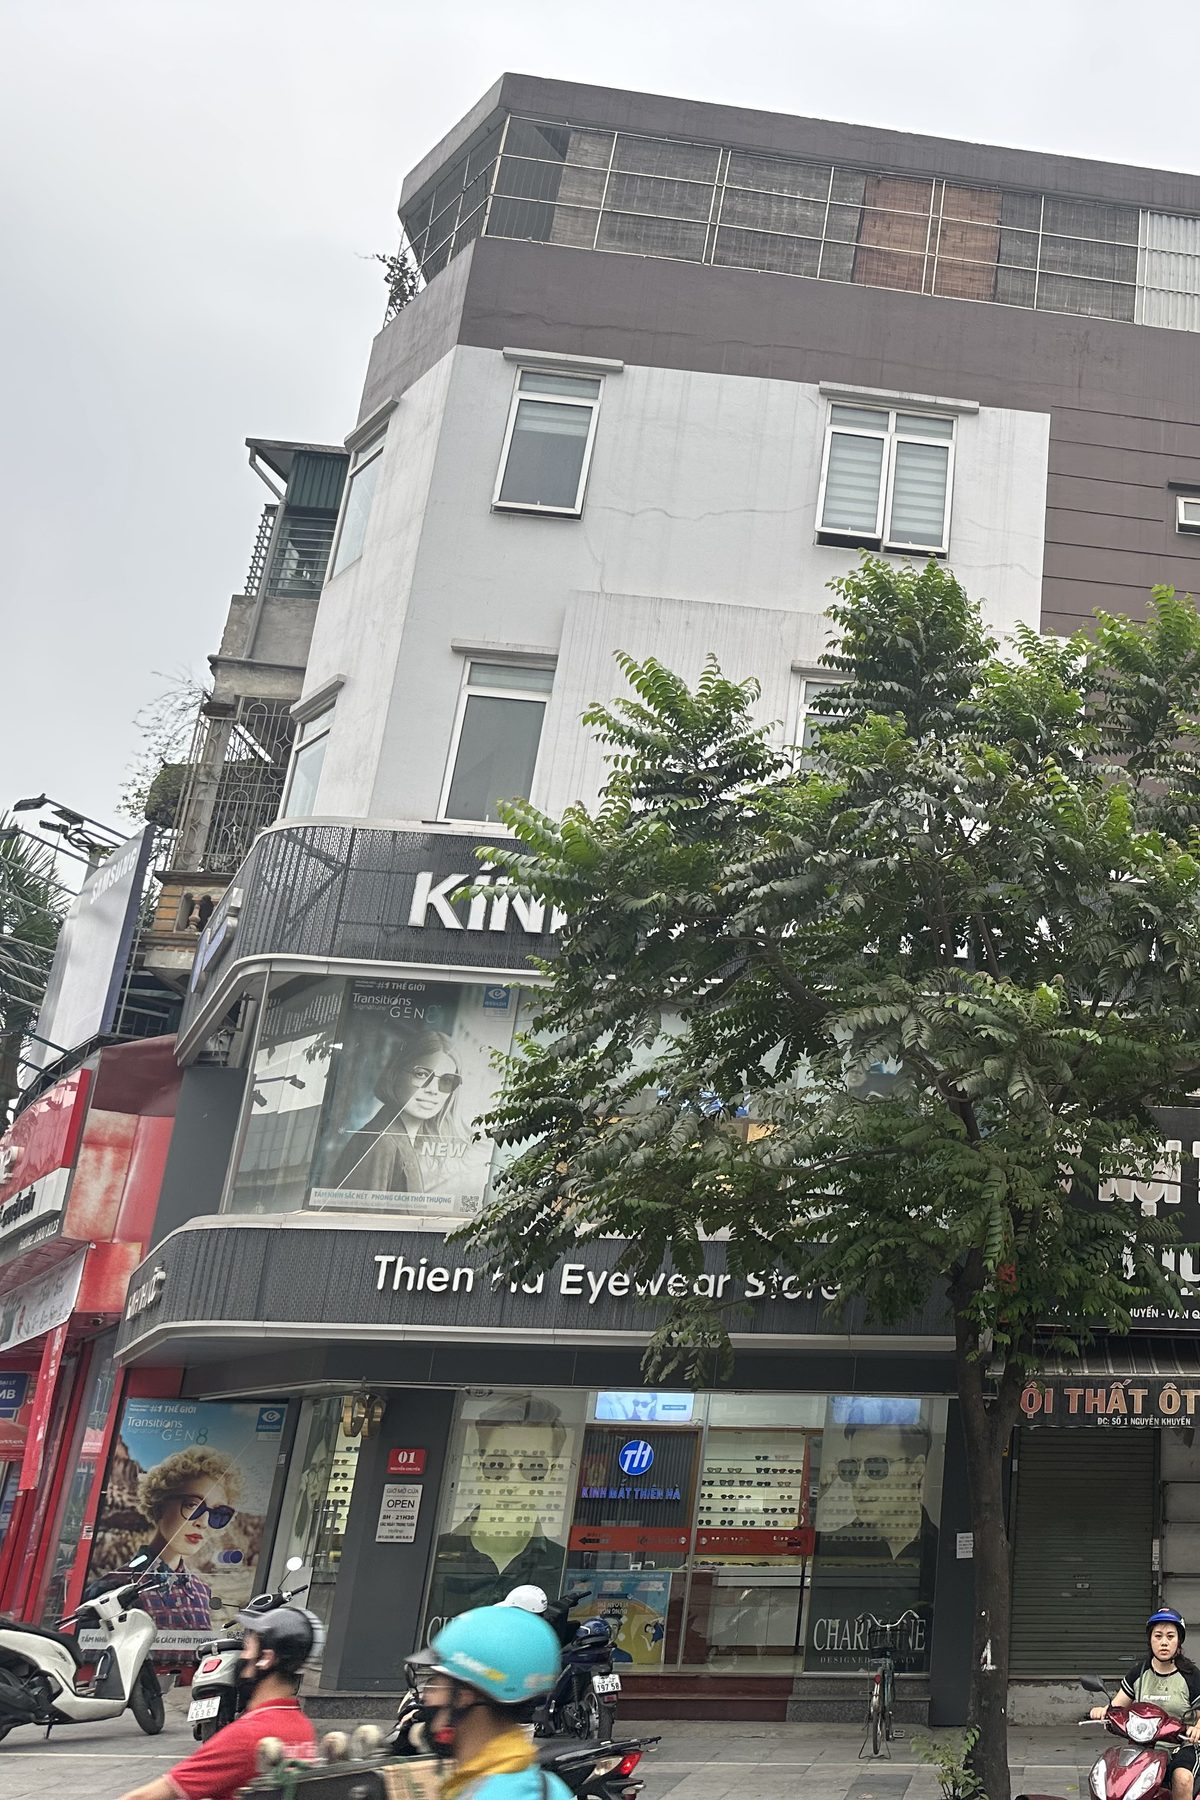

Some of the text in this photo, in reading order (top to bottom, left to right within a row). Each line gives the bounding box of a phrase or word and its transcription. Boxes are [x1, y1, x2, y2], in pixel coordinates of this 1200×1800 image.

[352, 992, 412, 1007] Transitions
[421, 1141, 468, 1158] NEW
[374, 1255, 474, 1293] Thien
[1063, 1379, 1148, 1414] THẤT
[127, 1416, 184, 1428] Transitions
[397, 1451, 416, 1464] 01
[386, 1499, 415, 1508] OPEN
